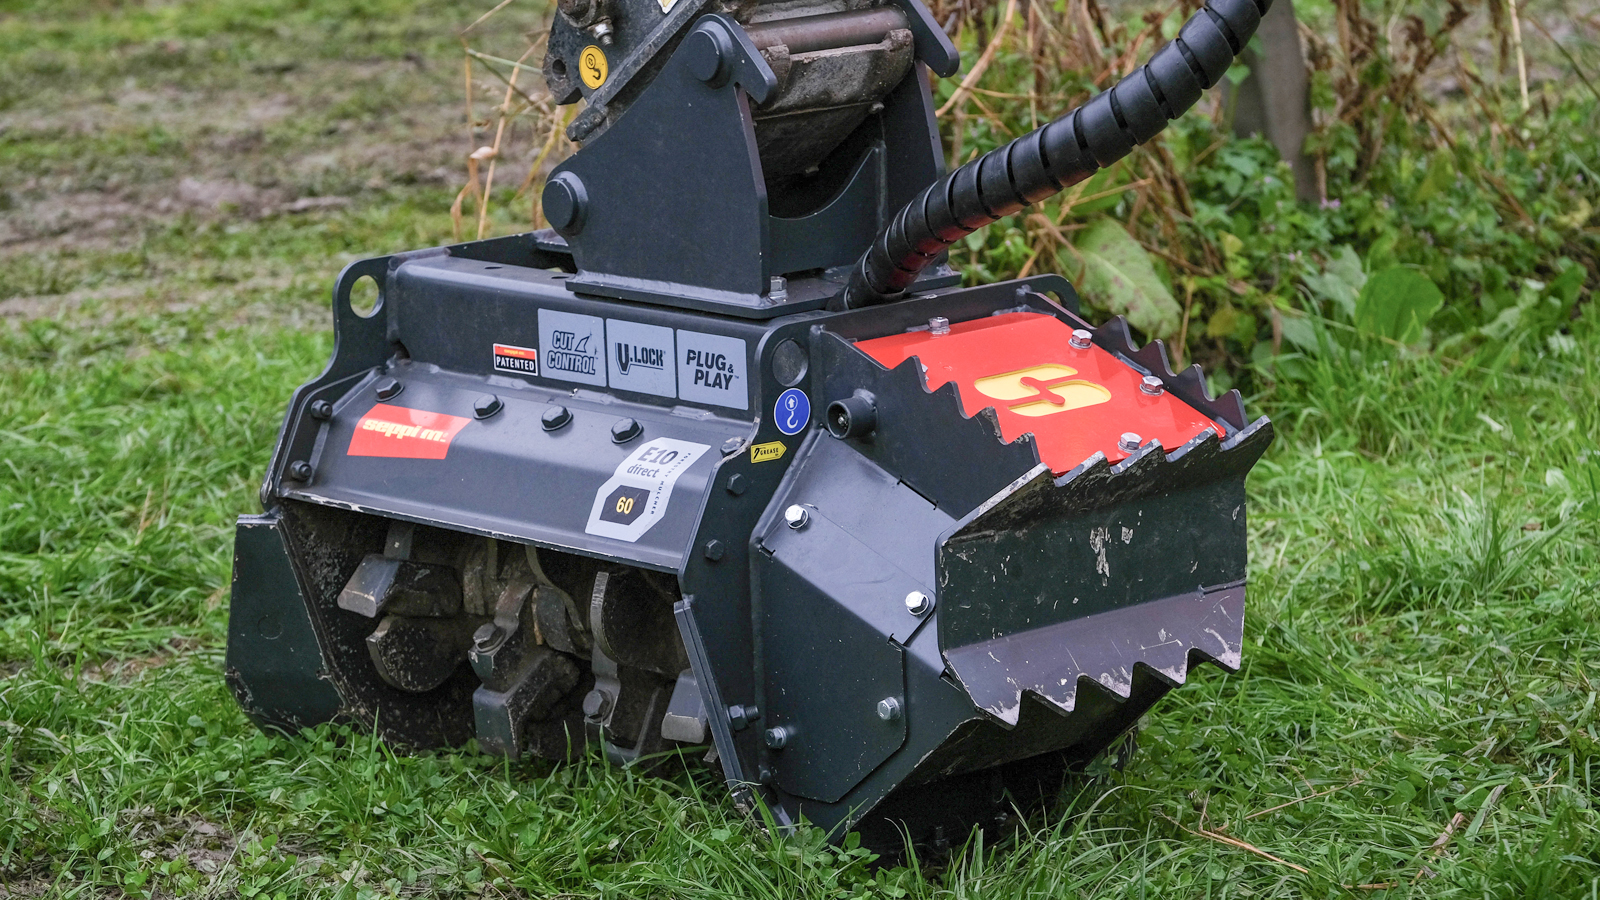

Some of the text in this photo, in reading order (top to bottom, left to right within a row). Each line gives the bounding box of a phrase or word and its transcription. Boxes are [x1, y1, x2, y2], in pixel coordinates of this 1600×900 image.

[552, 330, 575, 351] CUT
[496, 356, 535, 371] PATENTED
[547, 350, 596, 376] CONTROL
[686, 349, 734, 374] PLUG &
[694, 369, 733, 390] PLAY
[362, 419, 423, 439] seppi
[637, 446, 679, 465] E10
[760, 447, 779, 456] GREASE
[626, 463, 660, 478] direct
[615, 496, 635, 514] 60
